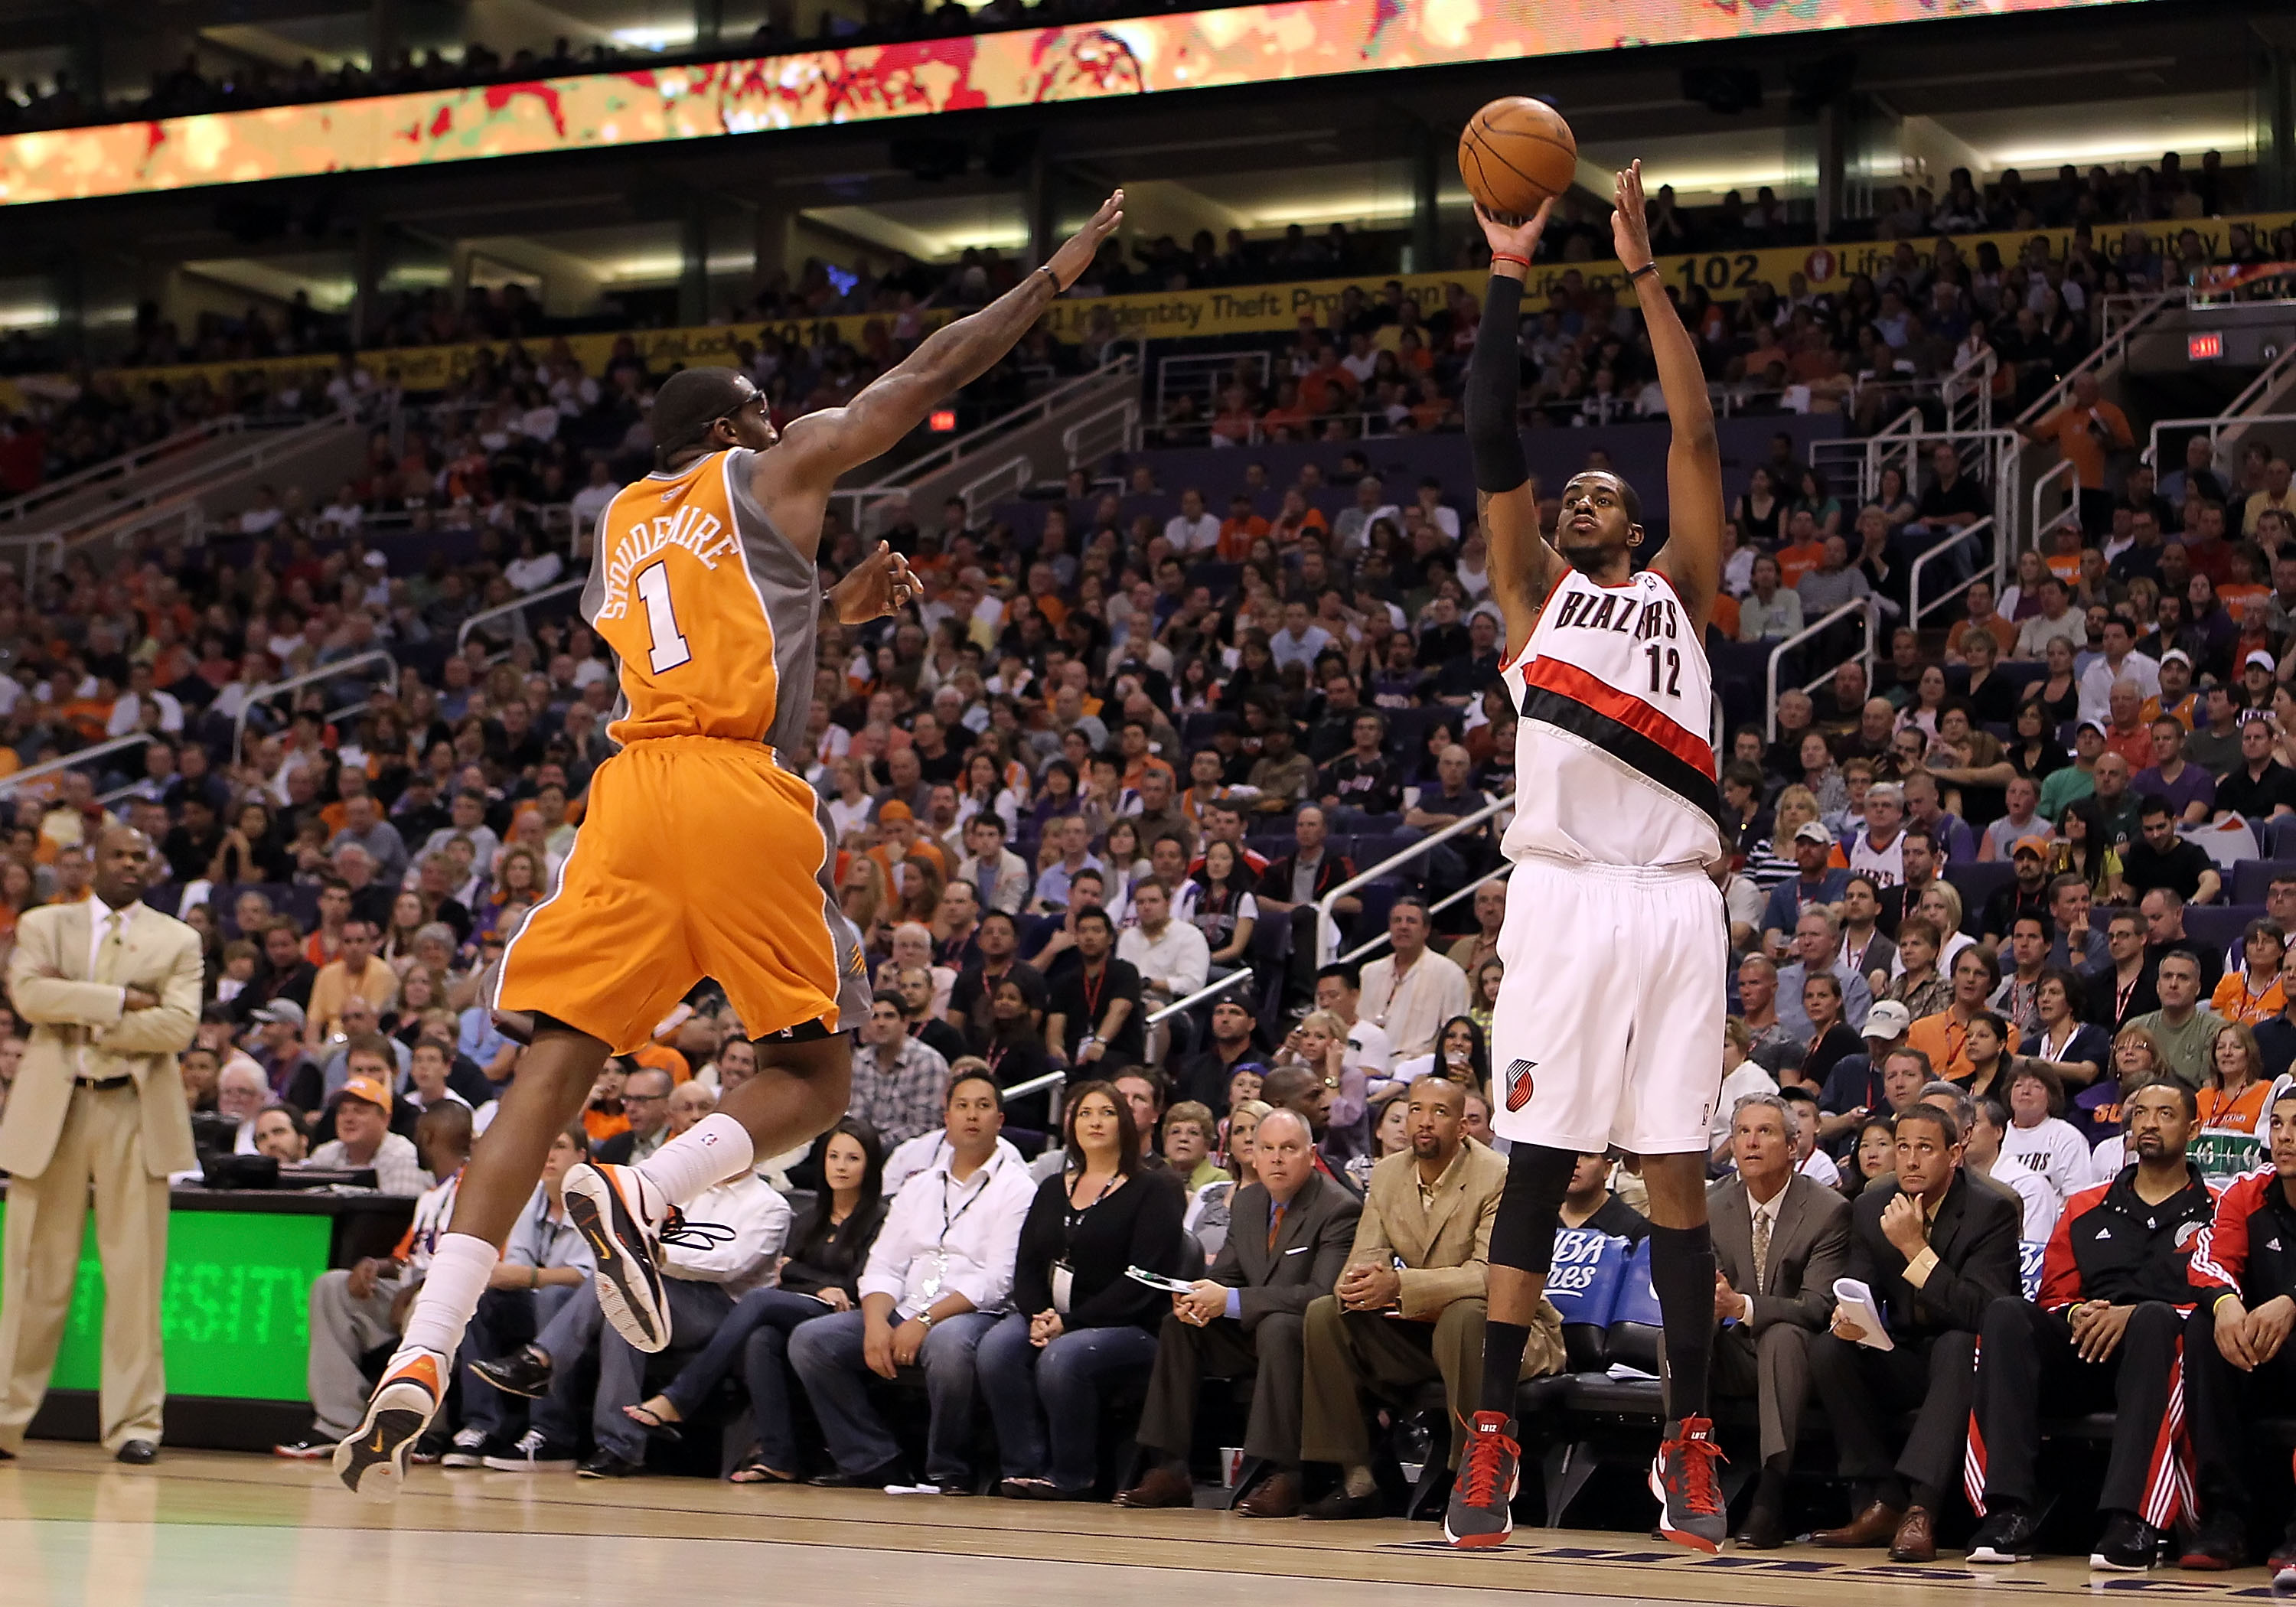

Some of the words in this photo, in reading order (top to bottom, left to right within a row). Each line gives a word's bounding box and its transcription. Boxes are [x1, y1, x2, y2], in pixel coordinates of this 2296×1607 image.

[1678, 254, 1759, 289] 102
[1112, 297, 1205, 329] dentity
[1212, 292, 1281, 319] Theft
[636, 559, 691, 675] 1
[1645, 644, 1681, 698] 12
